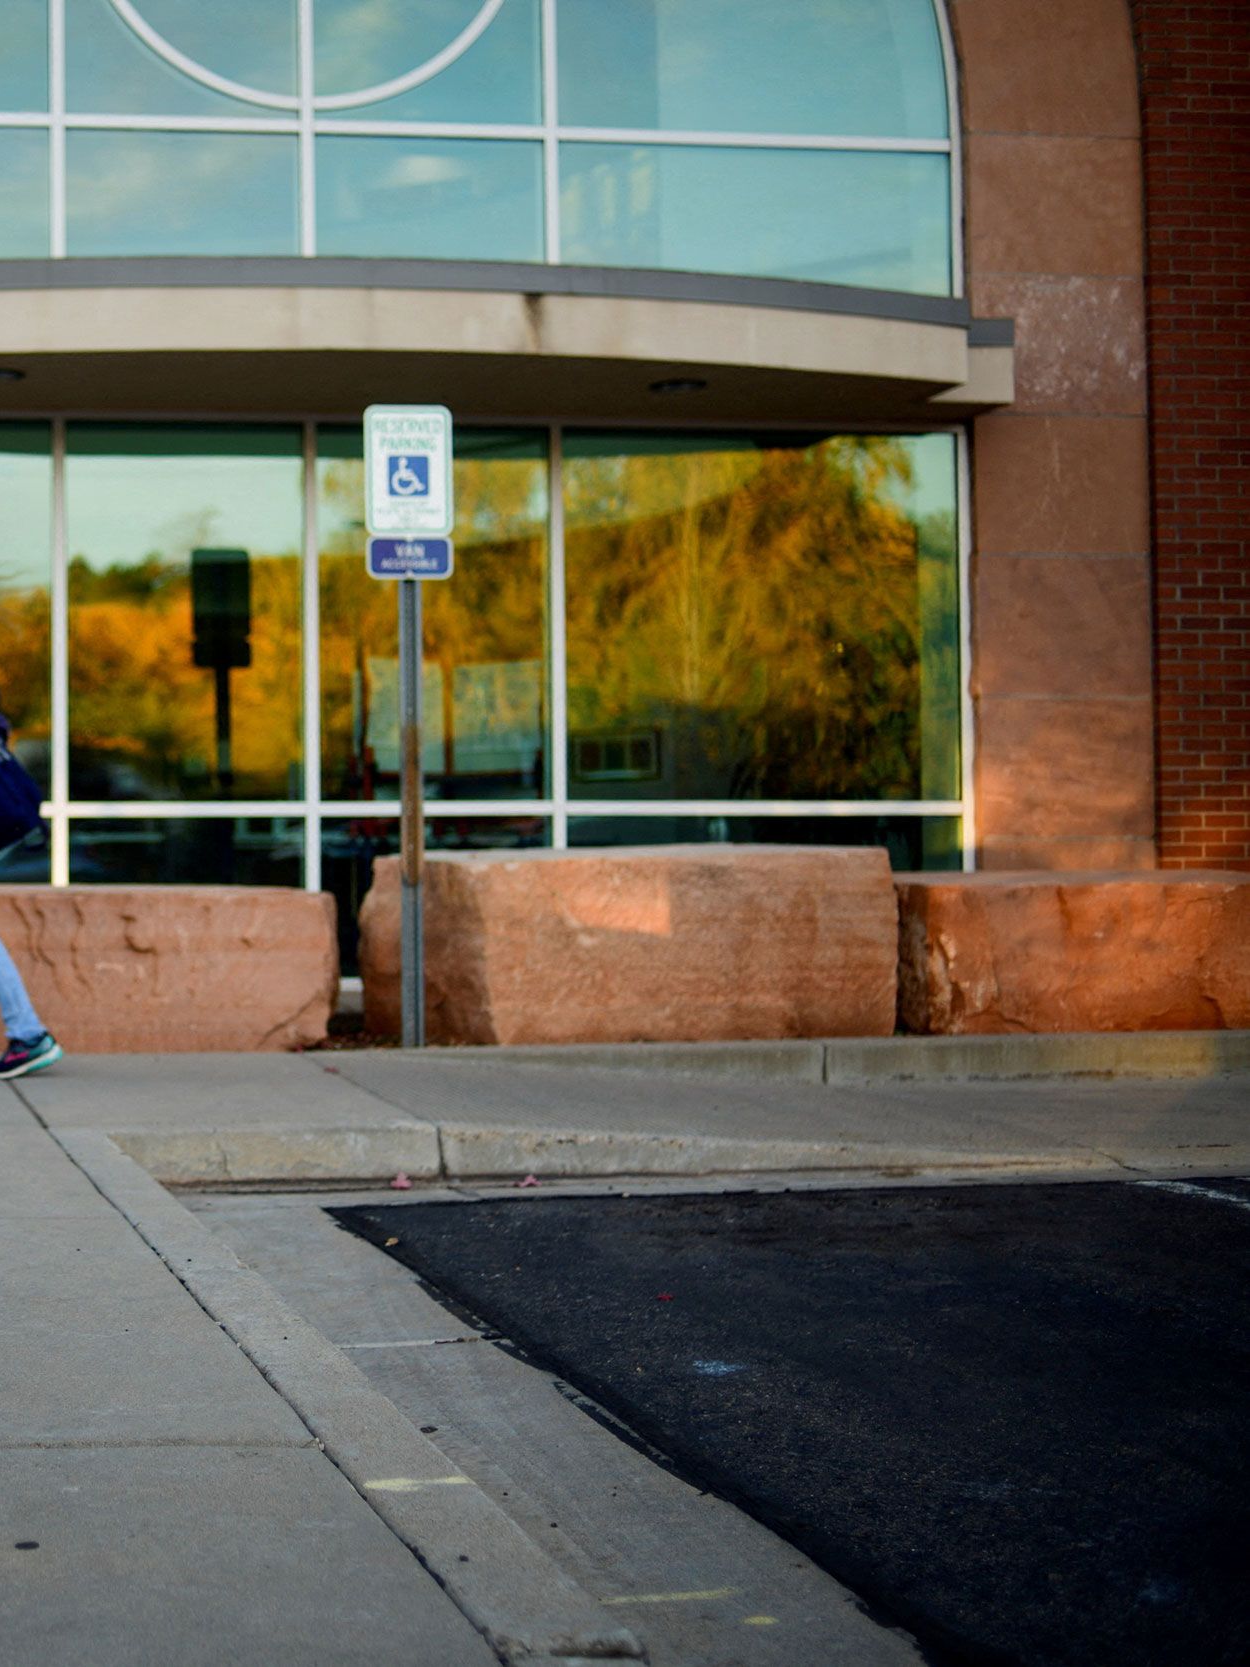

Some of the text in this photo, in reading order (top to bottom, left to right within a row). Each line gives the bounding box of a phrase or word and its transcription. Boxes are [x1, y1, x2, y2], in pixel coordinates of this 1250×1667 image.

[374, 418, 443, 433] RESERVED
[379, 435, 439, 449] PARKING
[394, 544, 426, 557] VAN
